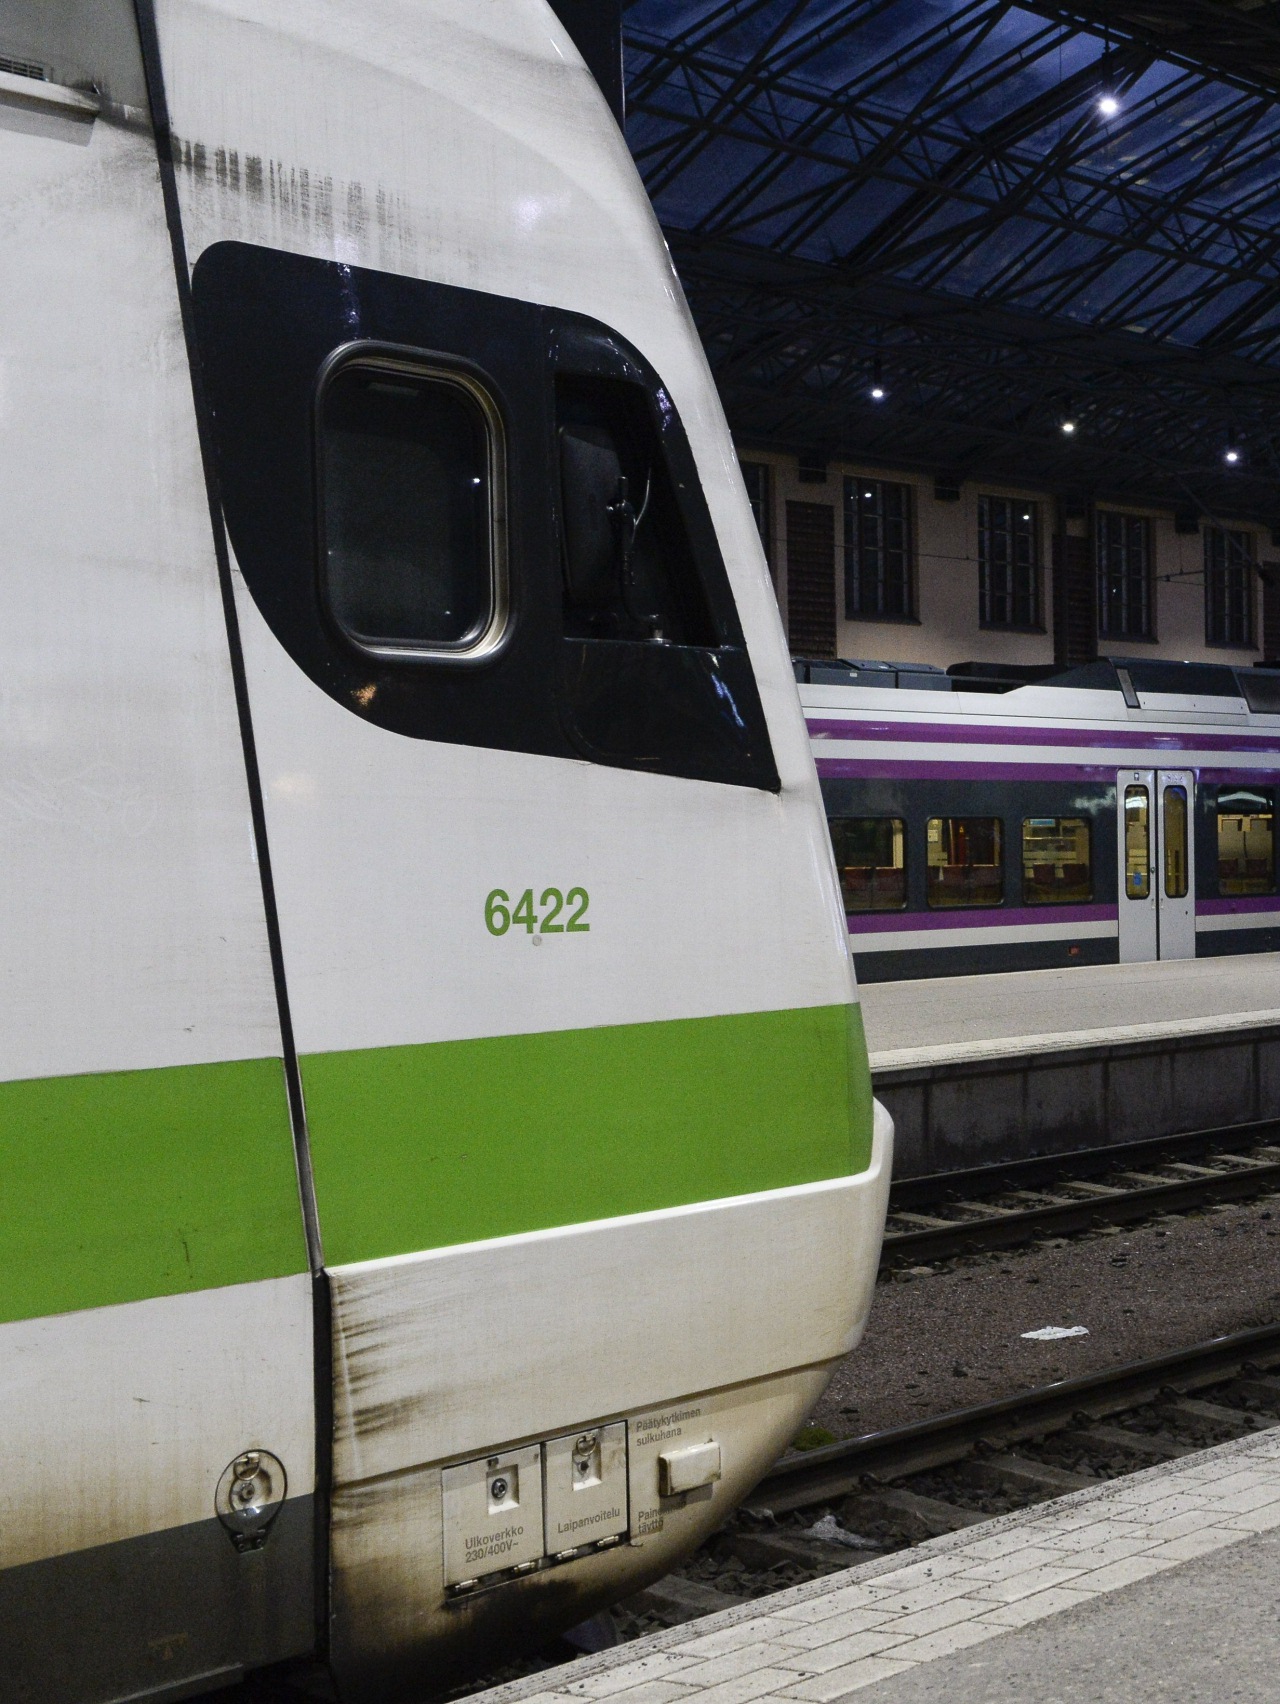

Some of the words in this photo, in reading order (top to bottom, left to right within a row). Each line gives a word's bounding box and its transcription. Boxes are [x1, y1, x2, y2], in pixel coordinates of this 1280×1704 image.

[484, 886, 591, 937] 6422
[636, 1427, 682, 1446] sulkuhana
[557, 1507, 621, 1534] Laipanvoitelu
[465, 1525, 524, 1549] Ulkoverkko
